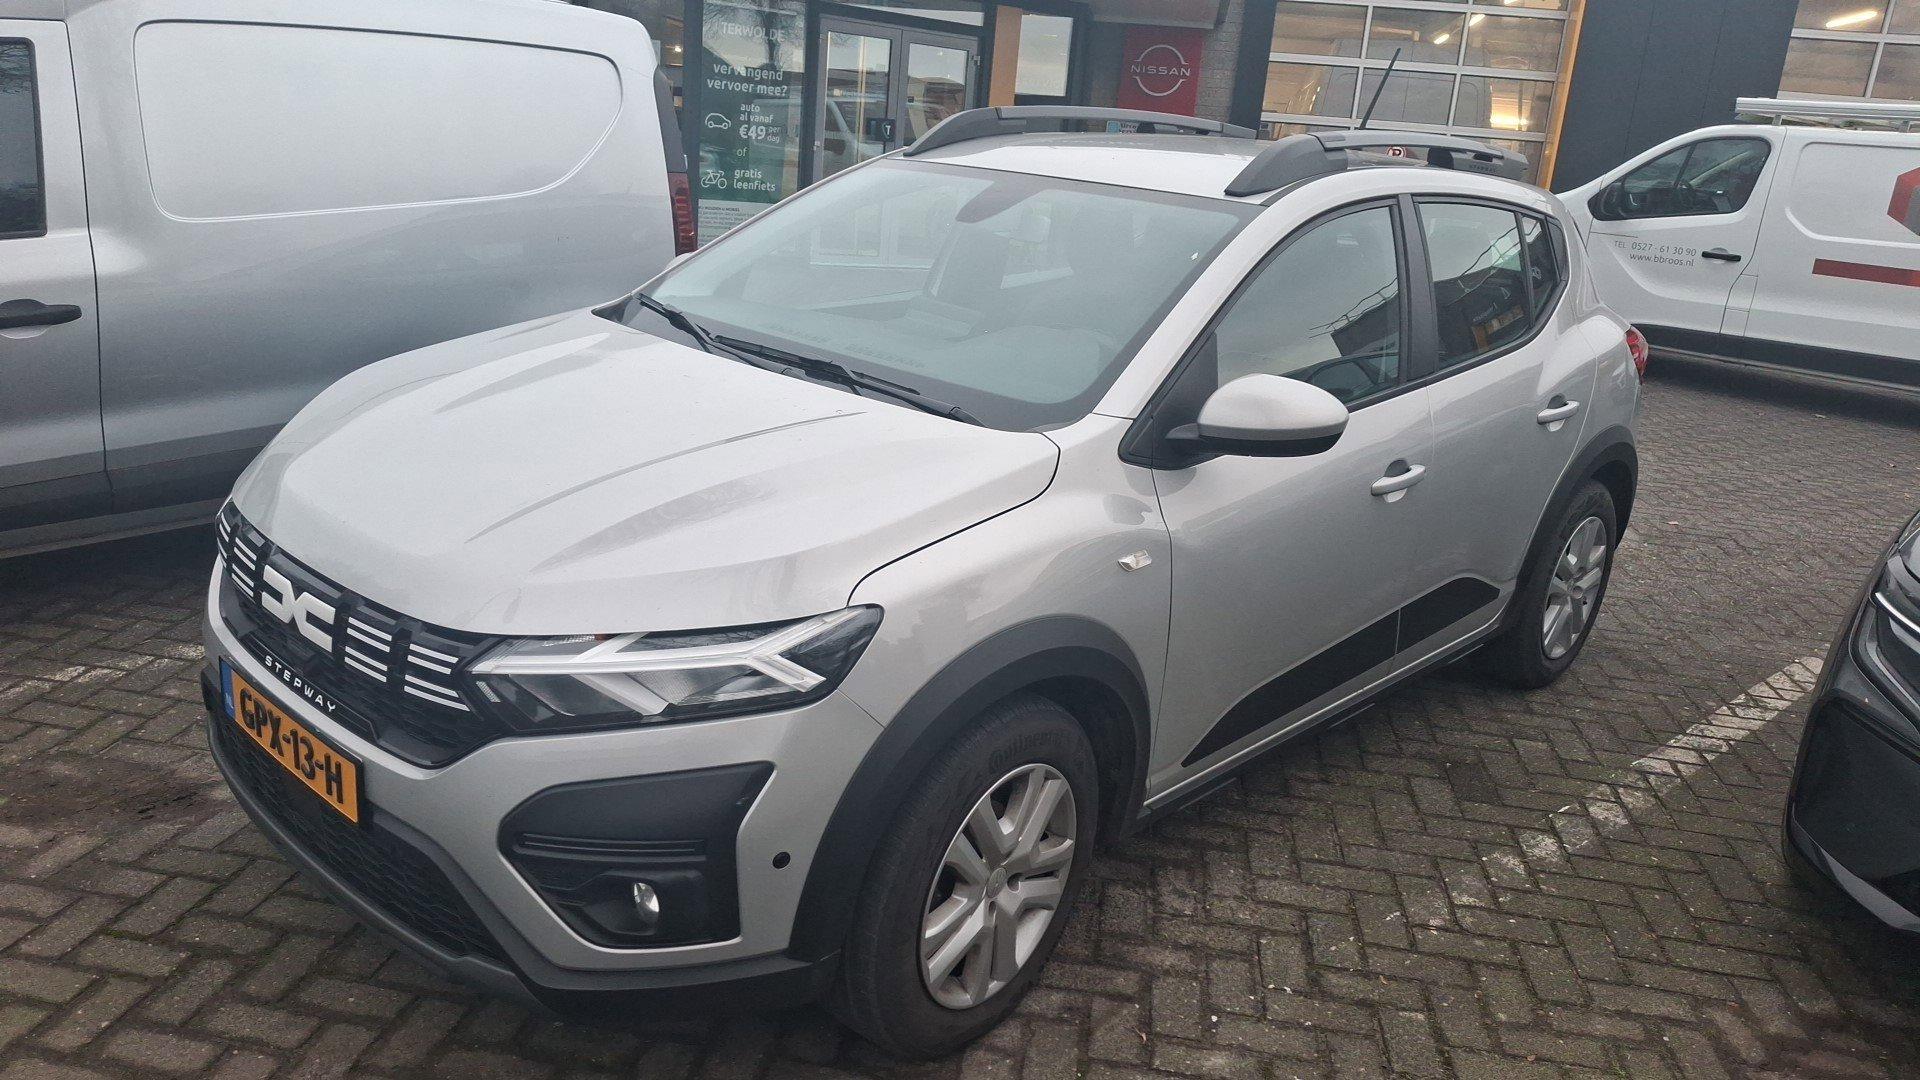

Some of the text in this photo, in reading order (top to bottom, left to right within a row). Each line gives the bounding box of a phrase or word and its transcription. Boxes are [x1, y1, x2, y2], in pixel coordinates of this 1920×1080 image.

[721, 21, 786, 43] TERWOLDE
[713, 63, 783, 81] vervangend
[1131, 63, 1191, 77] NISSAN
[706, 78, 788, 97] vervoer mee?
[740, 103, 760, 112] auto
[740, 112, 774, 124] al vanaf
[739, 124, 766, 140] €49
[767, 135, 780, 144] dag
[736, 147, 748, 157] of
[734, 168, 762, 179] gratis
[733, 179, 776, 192] leenfiets
[1614, 240, 1628, 249] TEL
[1631, 242, 1653, 251] 0527
[1659, 245, 1670, 253] 61
[1672, 246, 1684, 256] 30
[1685, 248, 1697, 257] 90
[1629, 253, 1695, 267] www.bbroos.nl
[264, 655, 336, 712] STEPWAY
[240, 687, 344, 804] GPX-13-H
